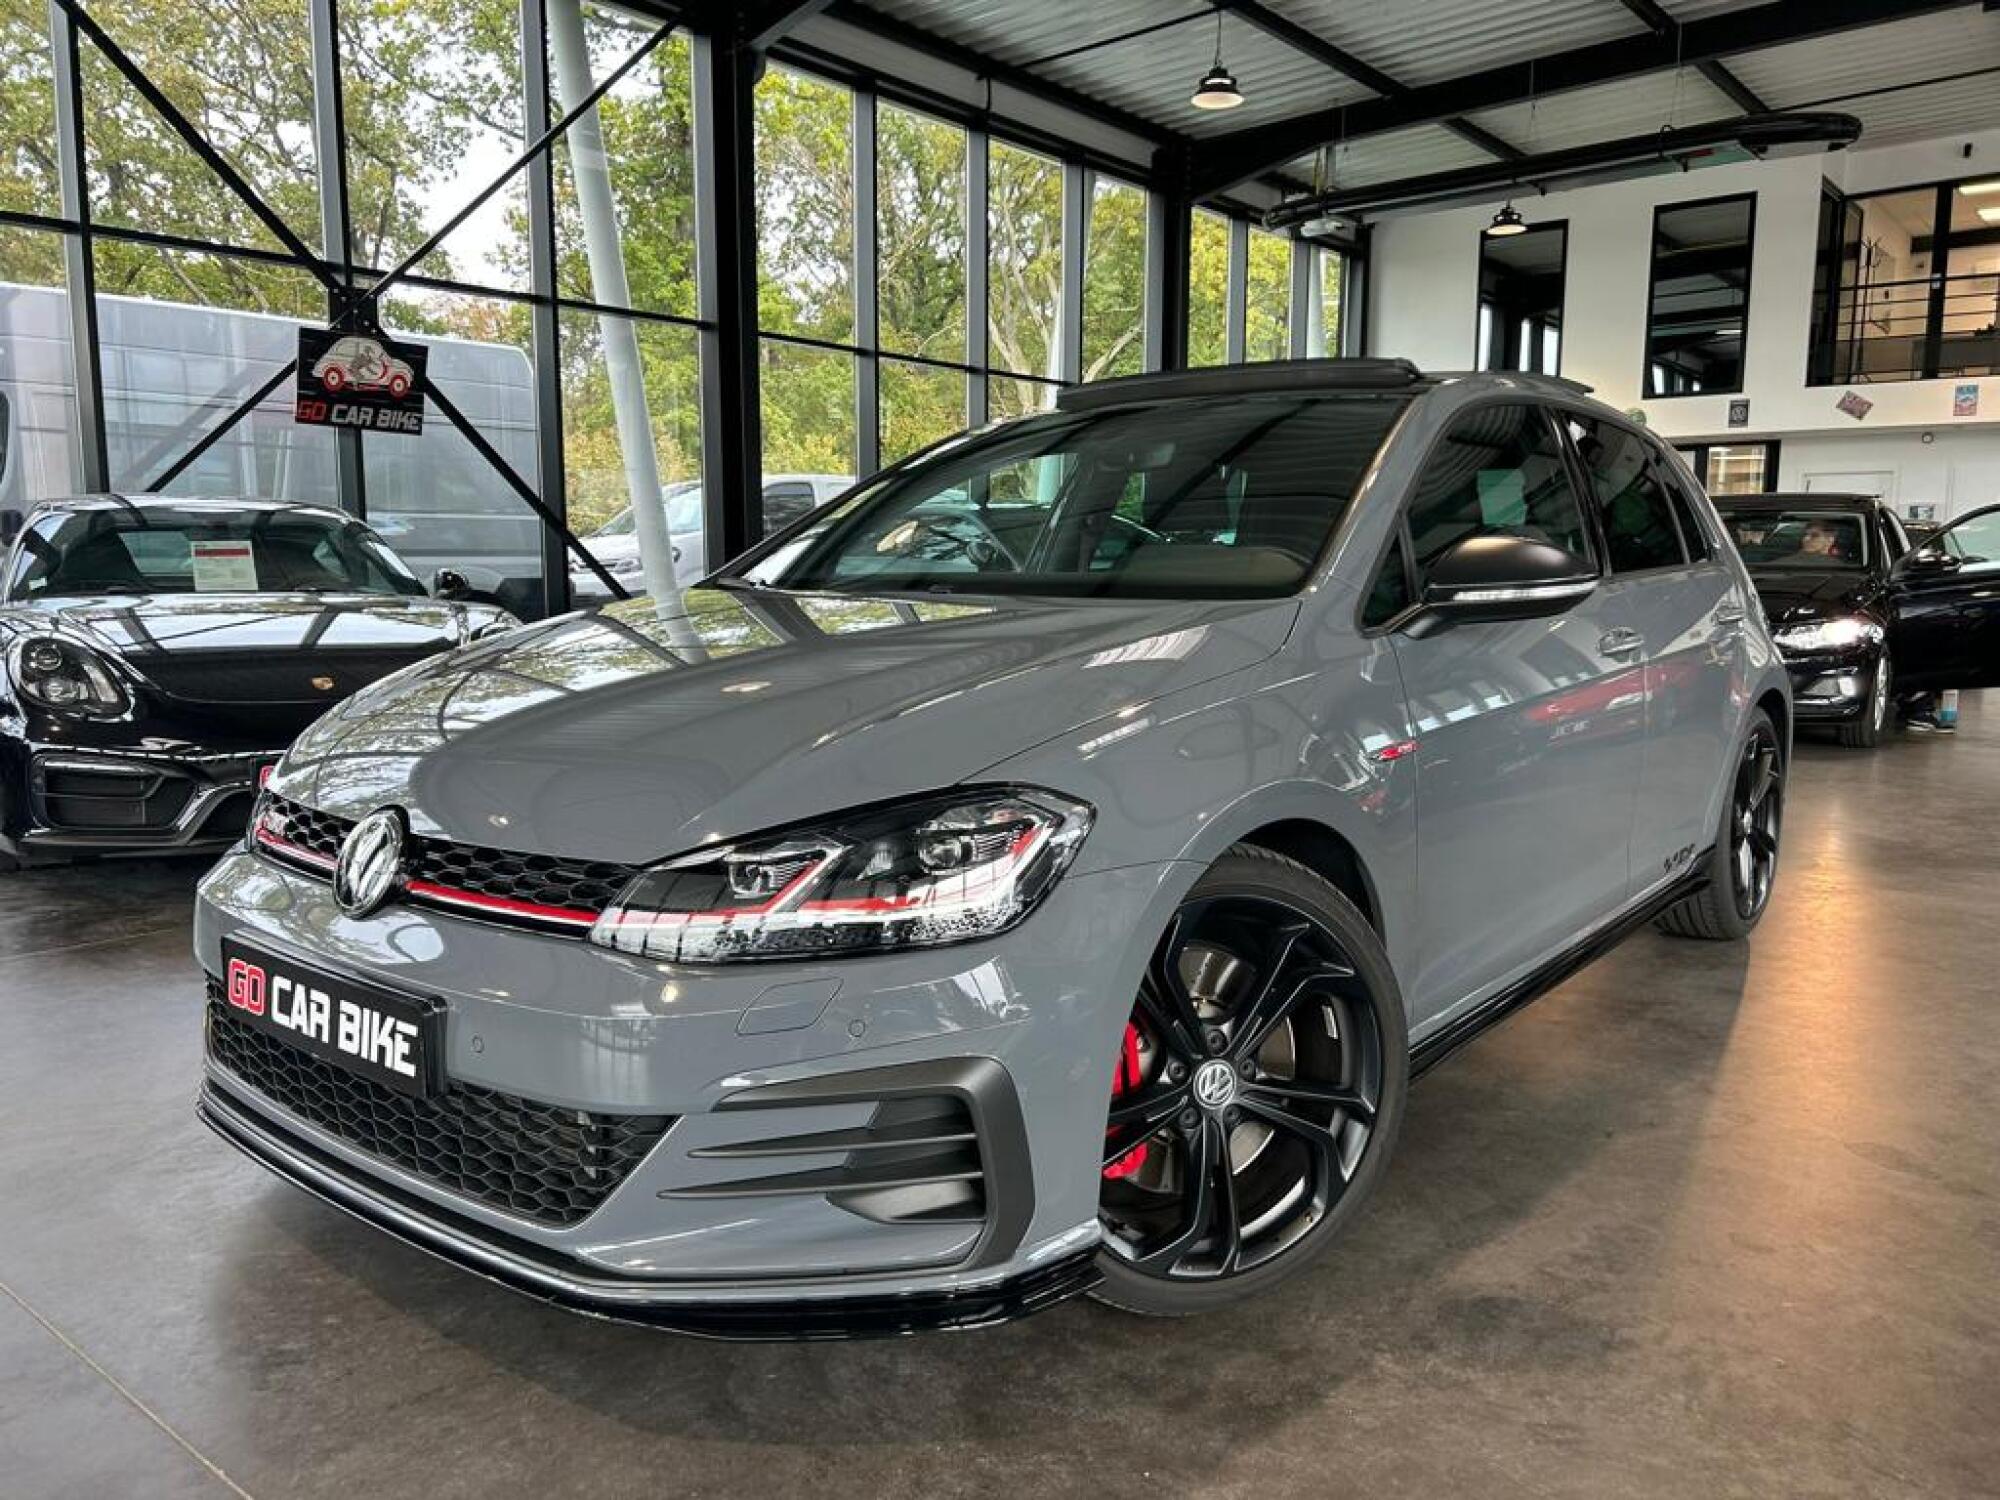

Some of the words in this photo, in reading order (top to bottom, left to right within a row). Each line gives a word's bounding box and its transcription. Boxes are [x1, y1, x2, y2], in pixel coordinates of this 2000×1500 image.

[298, 400, 327, 421] GO
[331, 403, 374, 426] CAR
[376, 409, 422, 430] BIKE
[228, 957, 266, 1016] GO
[271, 975, 331, 1044] CAR
[338, 999, 419, 1078] BIKE
